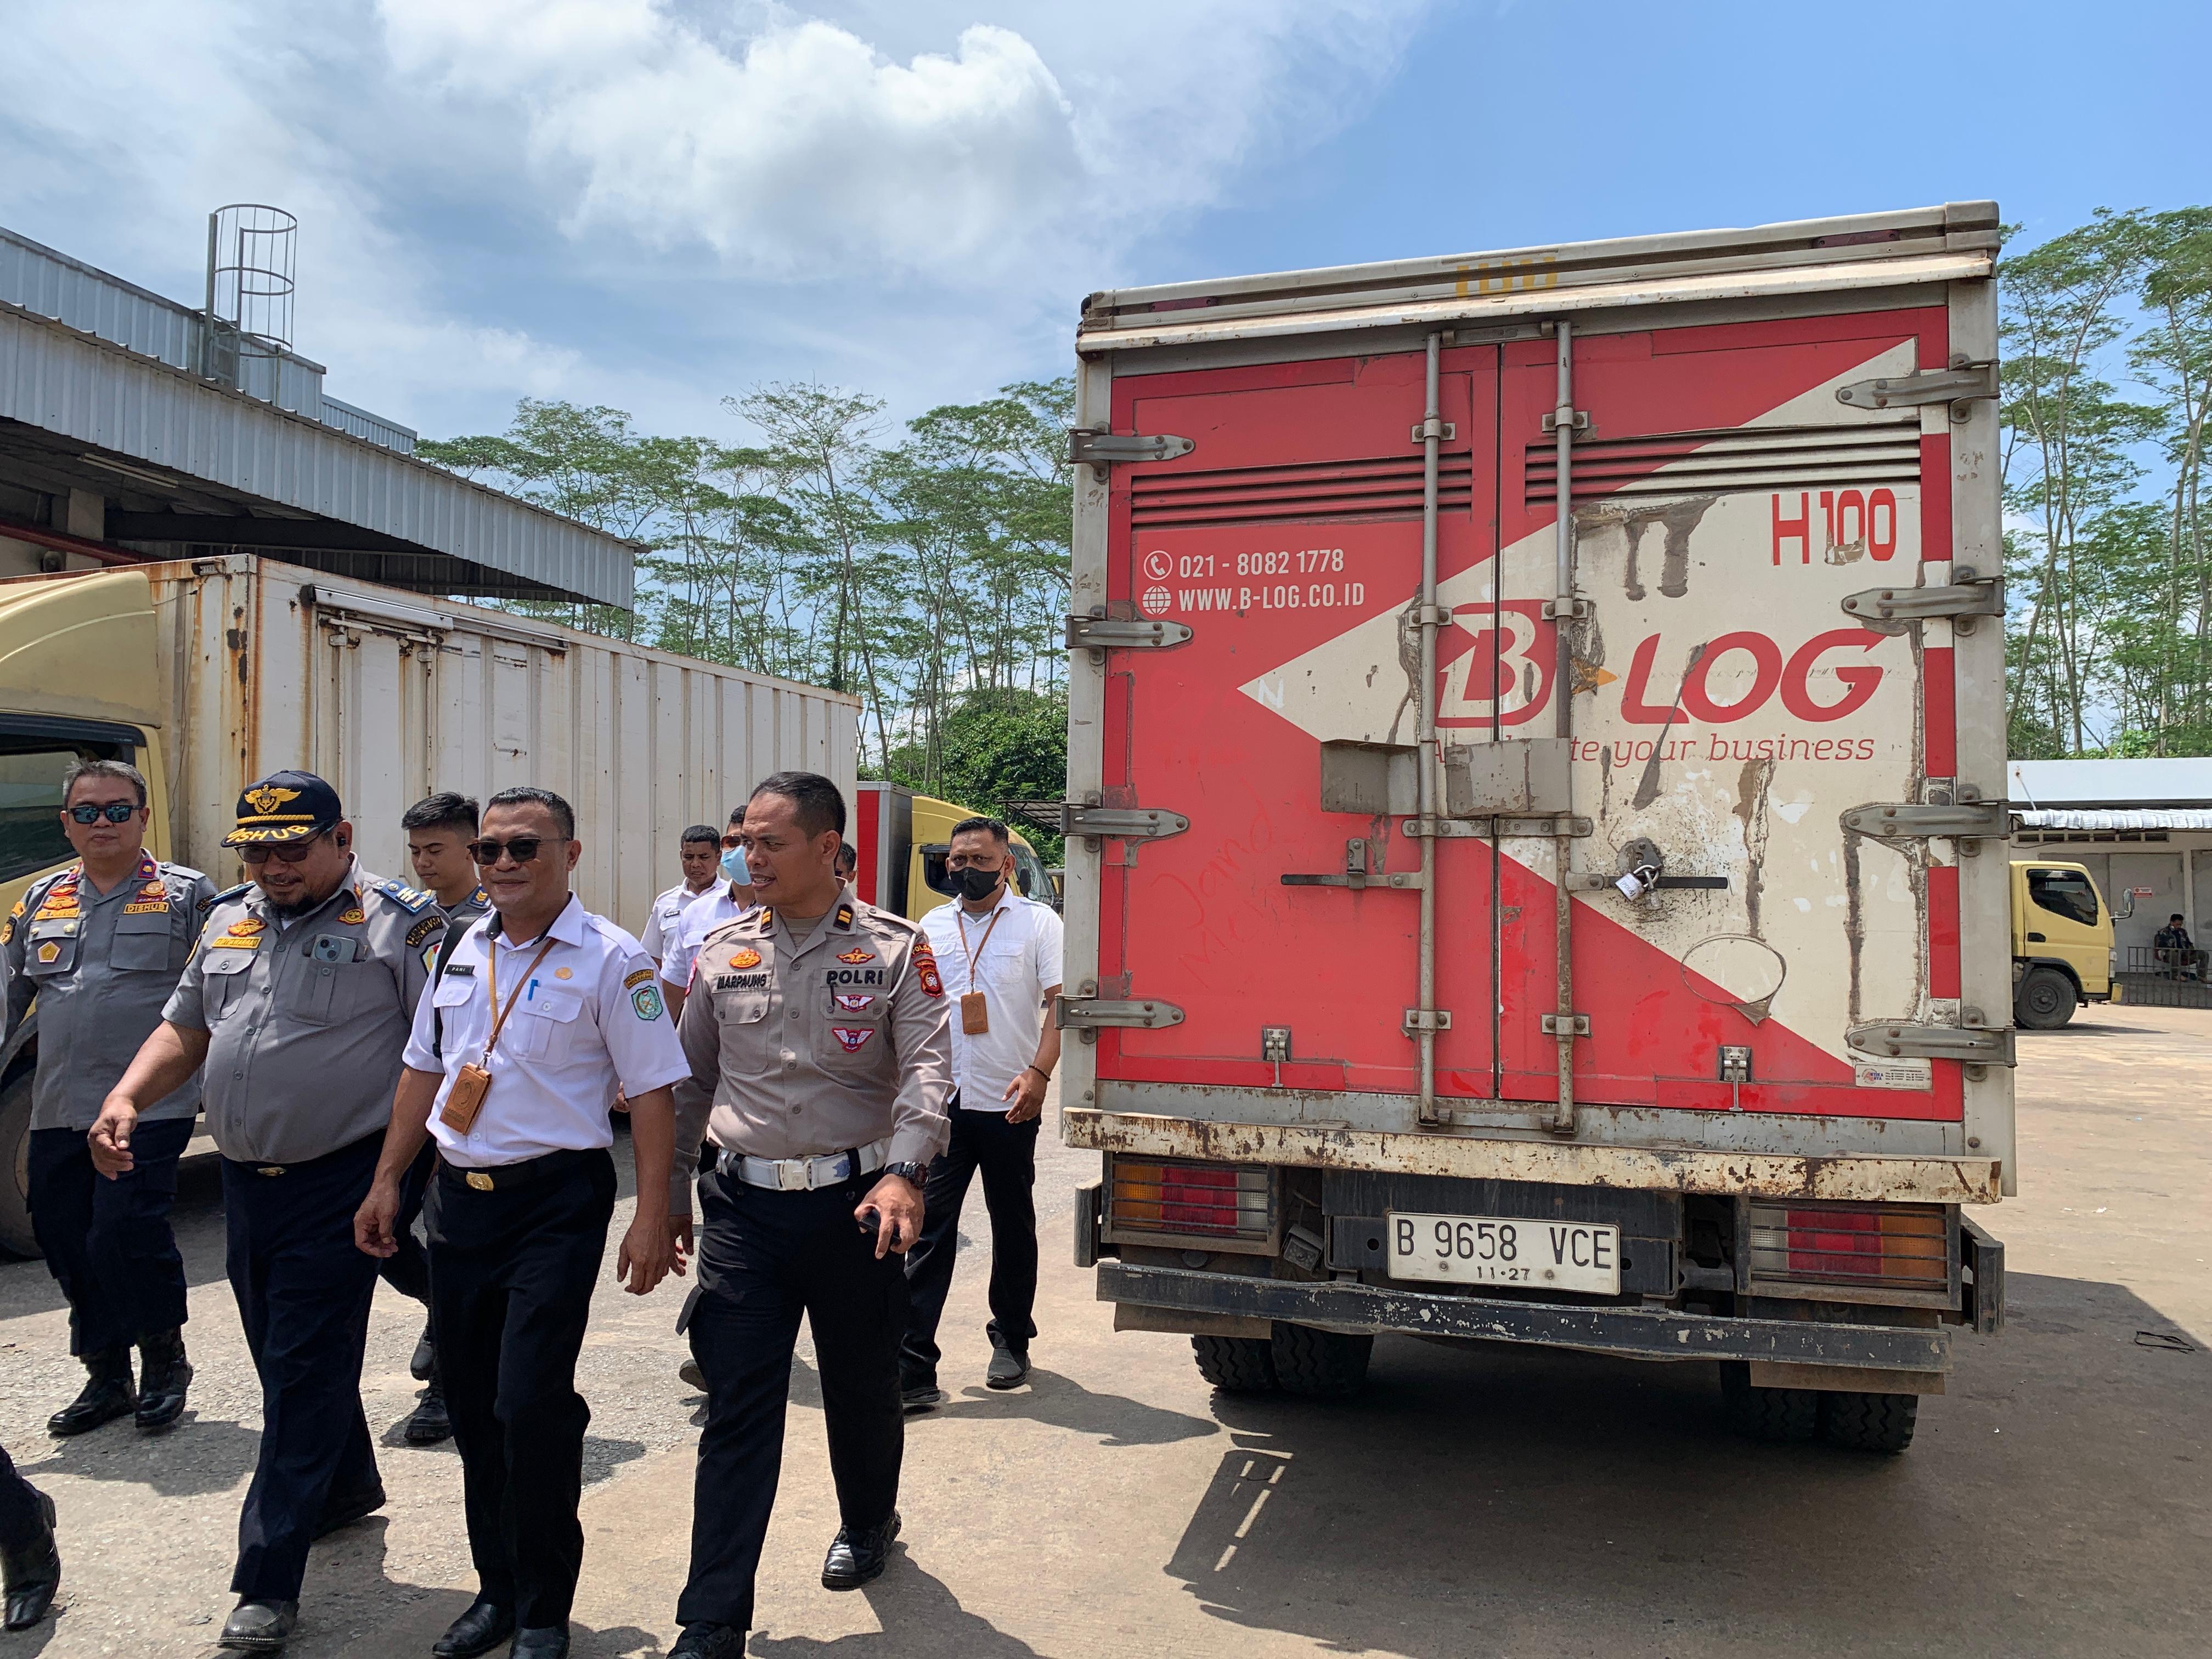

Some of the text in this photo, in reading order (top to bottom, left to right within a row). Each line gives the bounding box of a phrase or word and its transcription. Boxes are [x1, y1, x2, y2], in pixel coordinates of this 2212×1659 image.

[1180, 554, 1215, 578] 021
[1237, 551, 1289, 575] 8082
[1296, 549, 1344, 573] 1778
[1178, 582, 1365, 612] WWW.B-LOG.CO.ID
[1614, 736, 1697, 769] your
[1709, 733, 1875, 762] business
[225, 825, 309, 843] DISHUB
[127, 903, 165, 912] DISHUB
[716, 974, 768, 990] MARPAUNG
[826, 969, 883, 985] POLRI
[1397, 1219, 1612, 1269] B 9658 VCE
